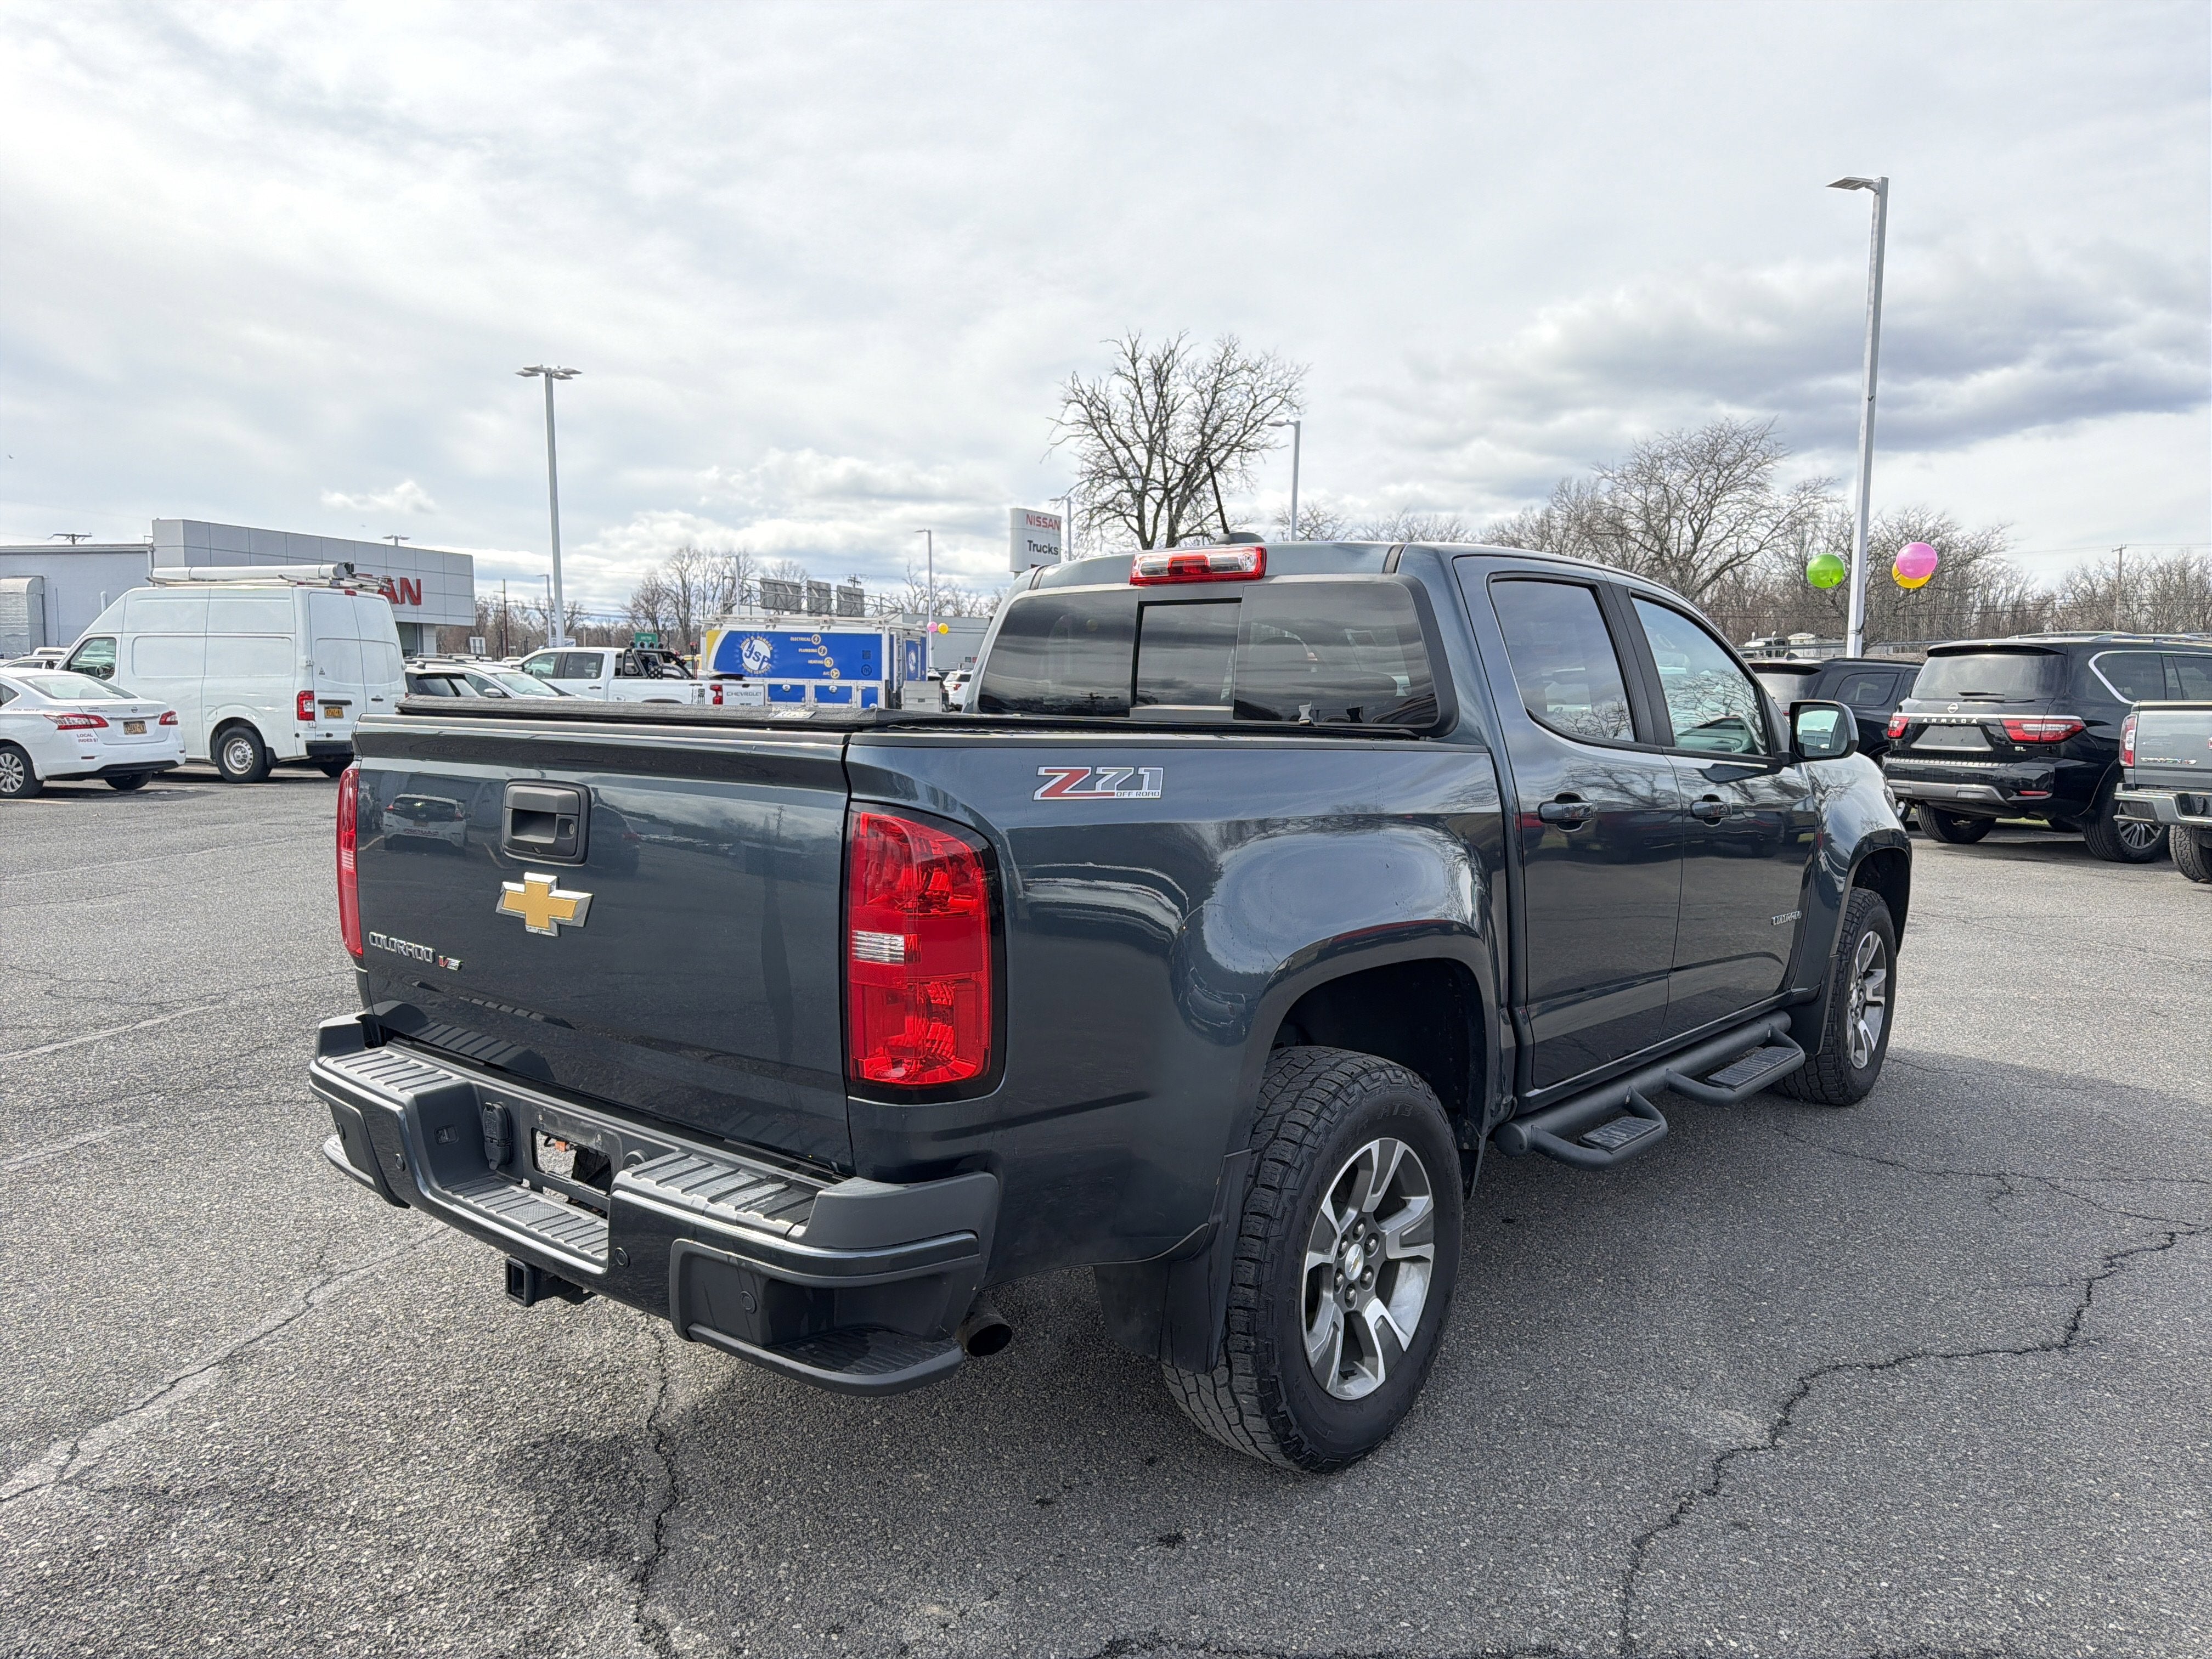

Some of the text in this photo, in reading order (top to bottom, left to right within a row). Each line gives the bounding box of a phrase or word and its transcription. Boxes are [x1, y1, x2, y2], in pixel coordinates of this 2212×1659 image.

[1026, 514, 1060, 531] NISSAN
[1027, 539, 1059, 556] Trucks
[1032, 765, 1165, 801] Z71
[1770, 910, 1802, 926] COLORADO
[369, 931, 437, 964] COLORADO
